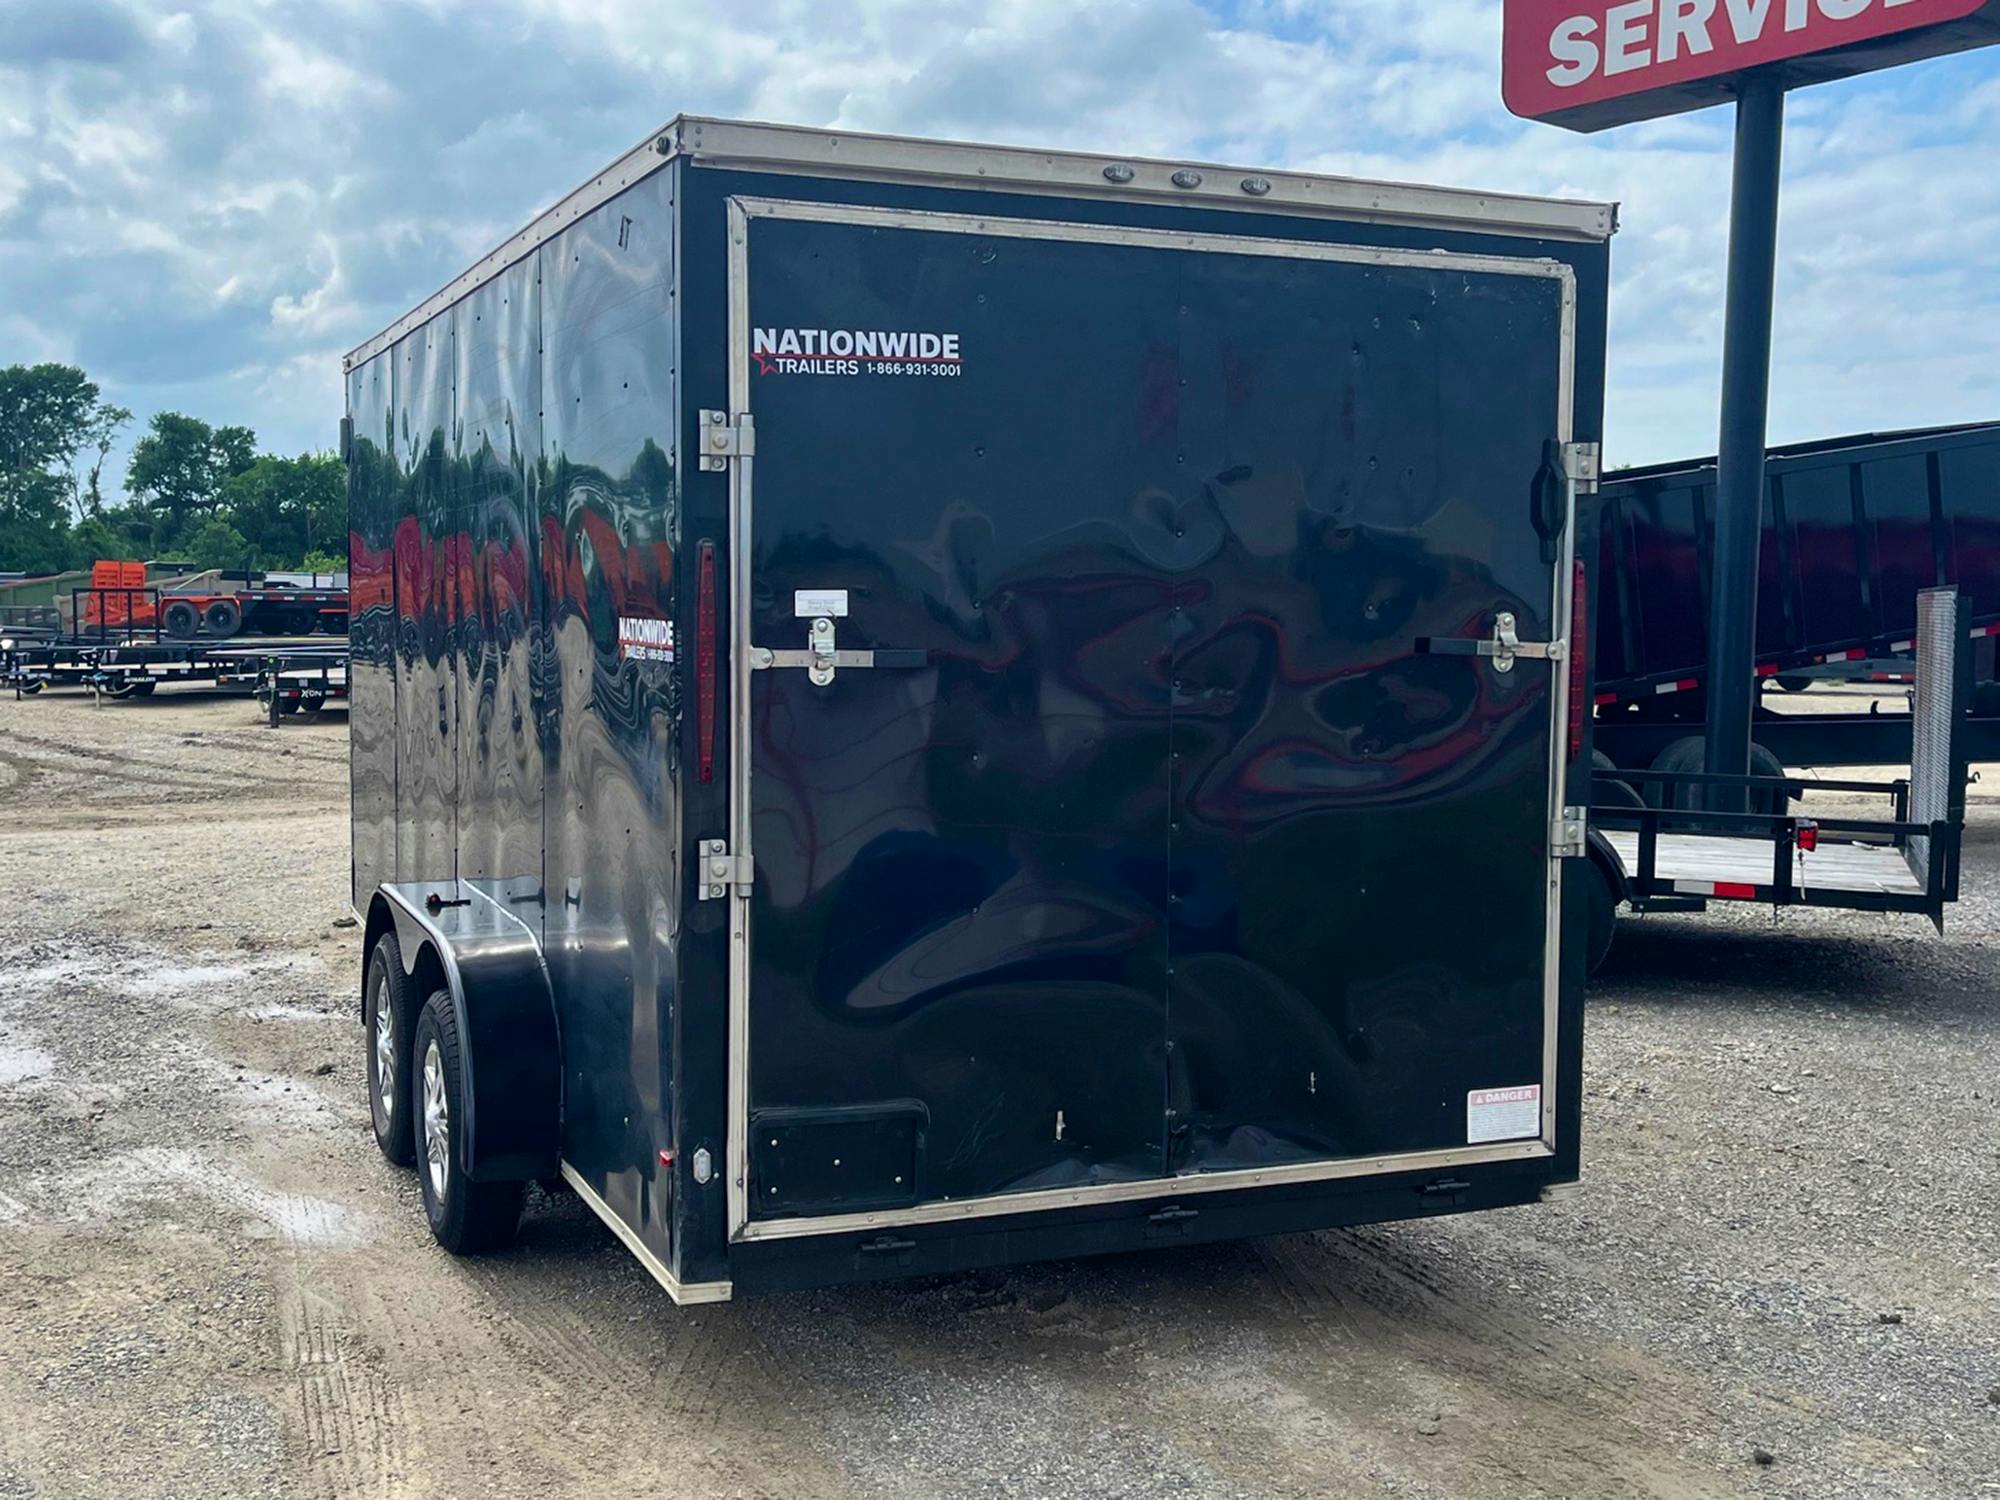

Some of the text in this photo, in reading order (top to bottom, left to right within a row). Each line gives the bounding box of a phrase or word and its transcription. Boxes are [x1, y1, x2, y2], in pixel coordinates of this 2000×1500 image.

[1545, 0, 1921, 87] SERVI
[753, 327, 960, 359] NATIONWIDE
[775, 358, 961, 377] TRAILERS 1-866-931-3001
[618, 616, 674, 646] NATIONWIDE
[1485, 1090, 1532, 1102] DANGER
